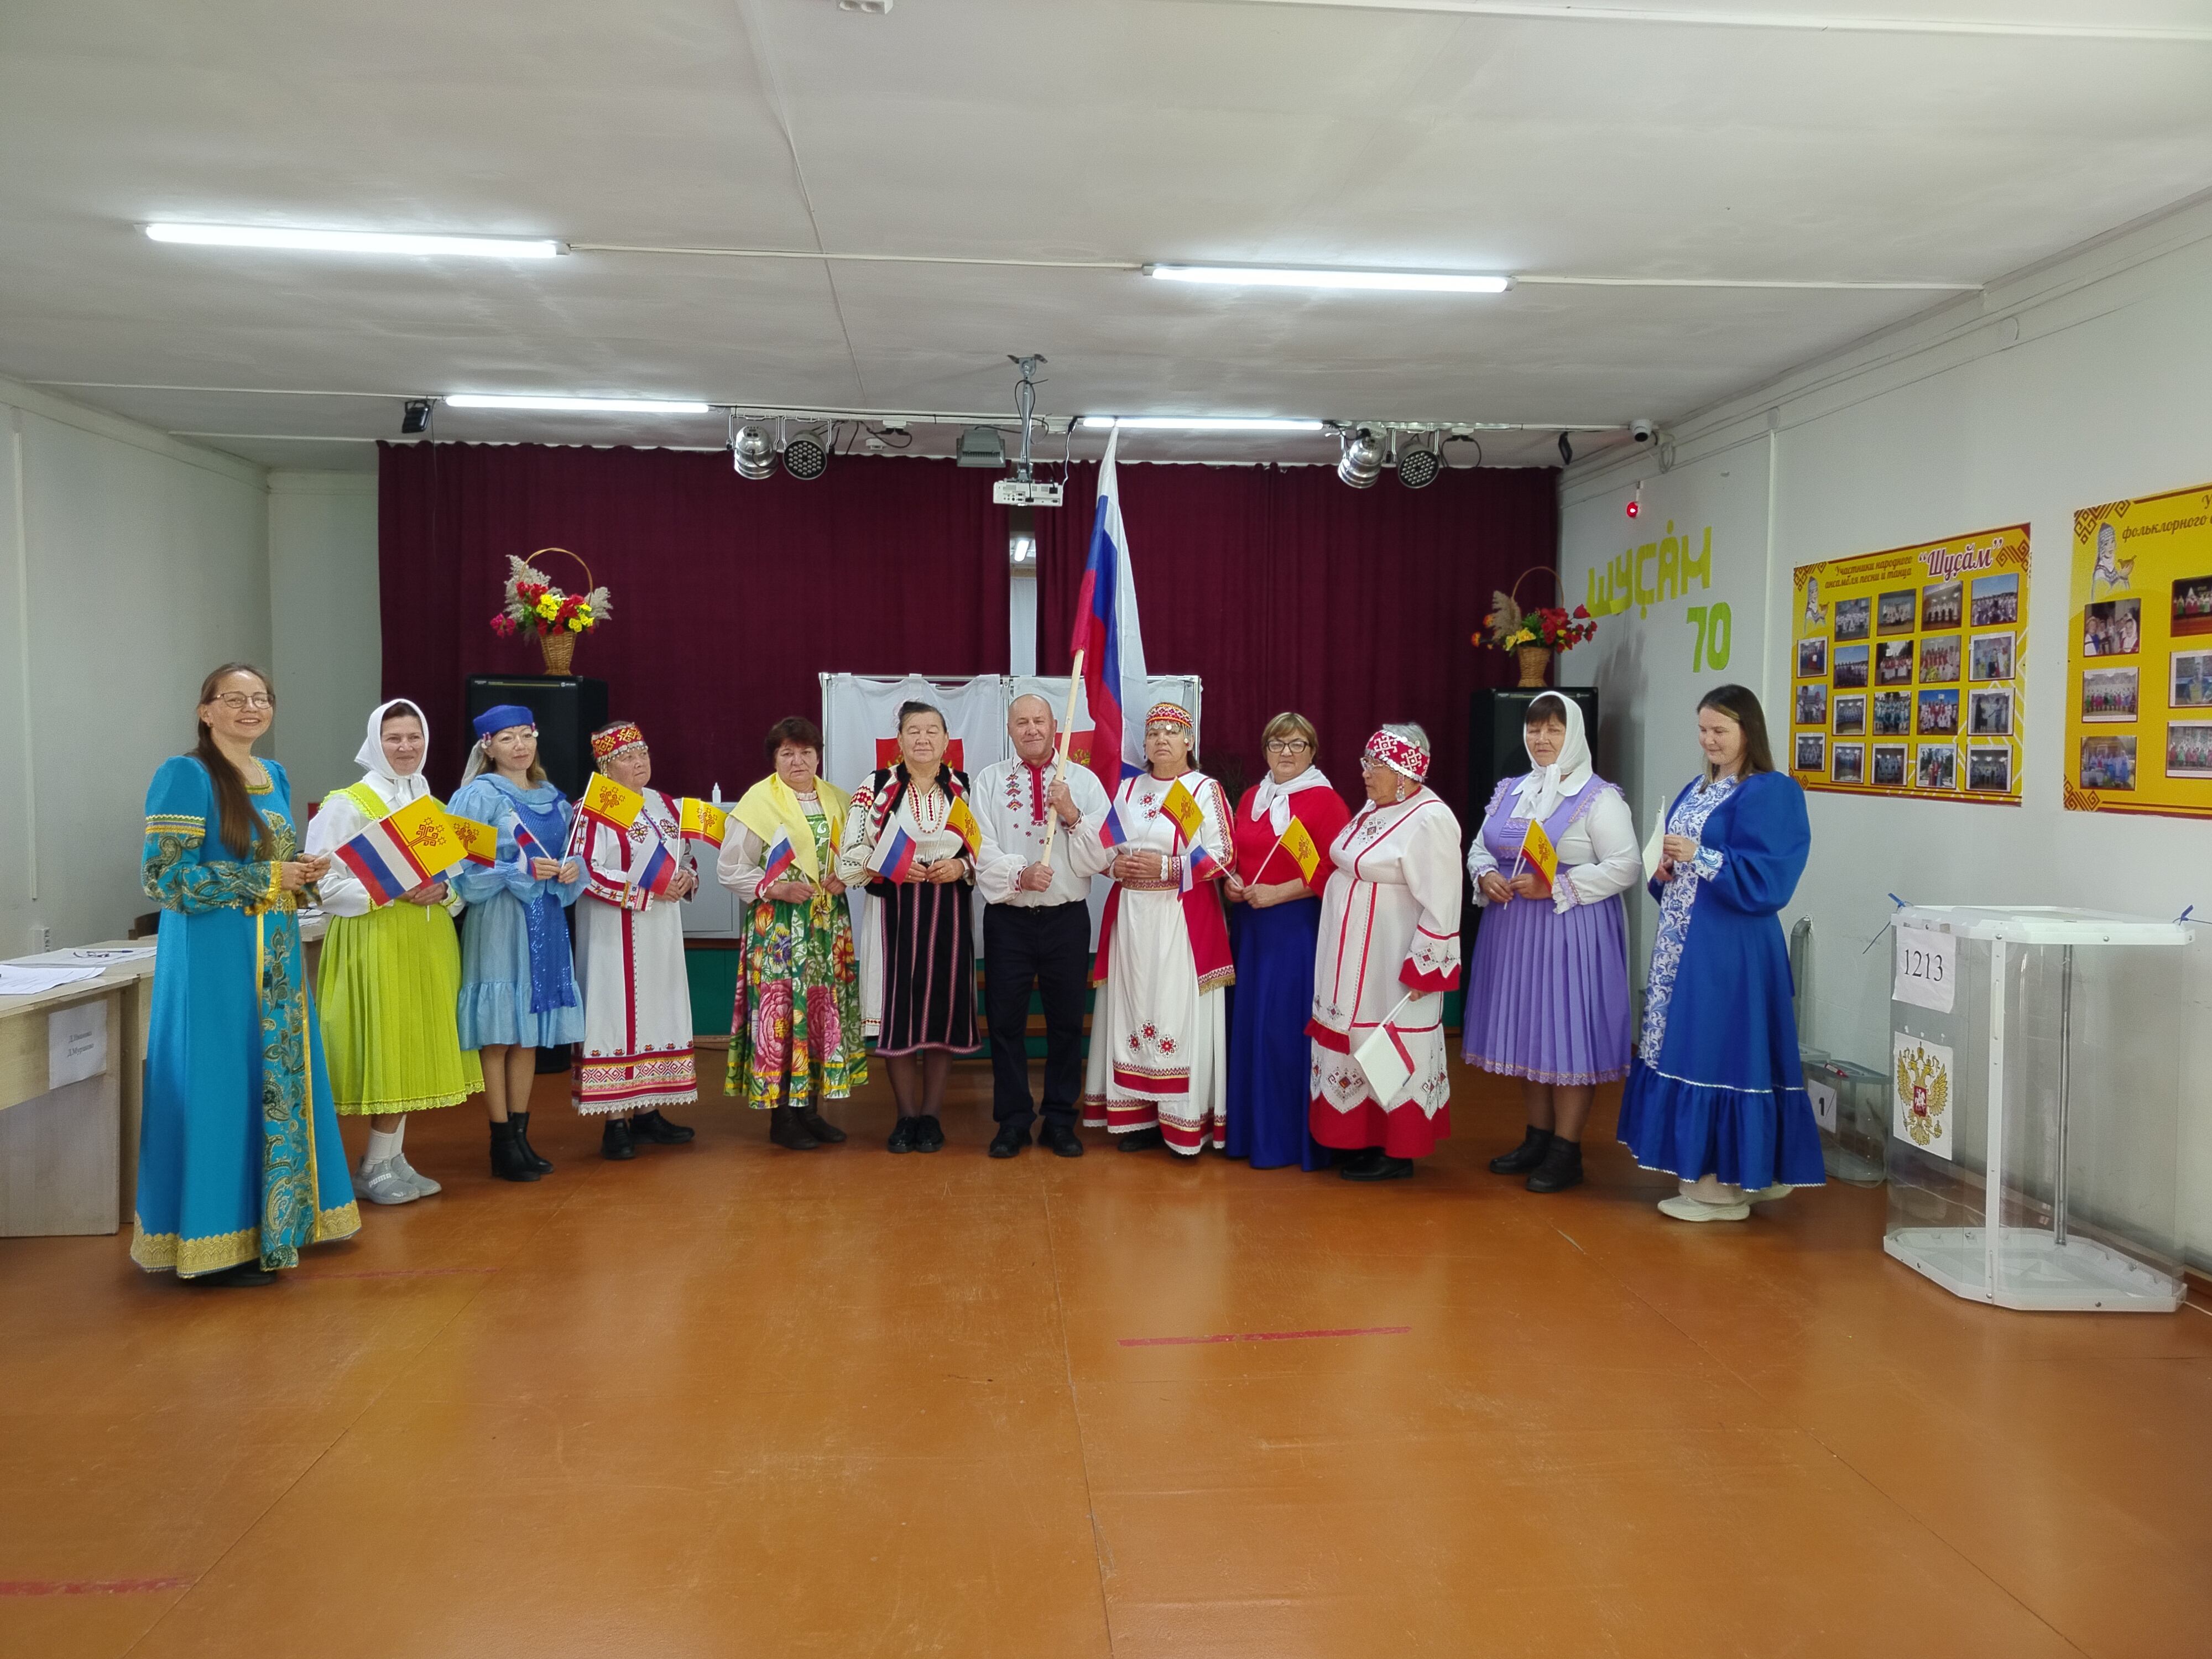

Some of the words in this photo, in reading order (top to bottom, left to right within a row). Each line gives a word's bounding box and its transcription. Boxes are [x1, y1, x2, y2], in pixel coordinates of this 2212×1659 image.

[2122, 515, 2208, 543] фольклорного
[1825, 575, 1858, 588] ансамбля
[1860, 573, 1880, 583] песни
[1881, 571, 1886, 580] и
[1887, 568, 1912, 579] танца
[1835, 562, 1875, 576] Участники
[1876, 556, 1912, 571] народного
[1687, 602, 1731, 672] 70
[1905, 949, 1943, 981] 1213
[1819, 1097, 1824, 1116] 1
